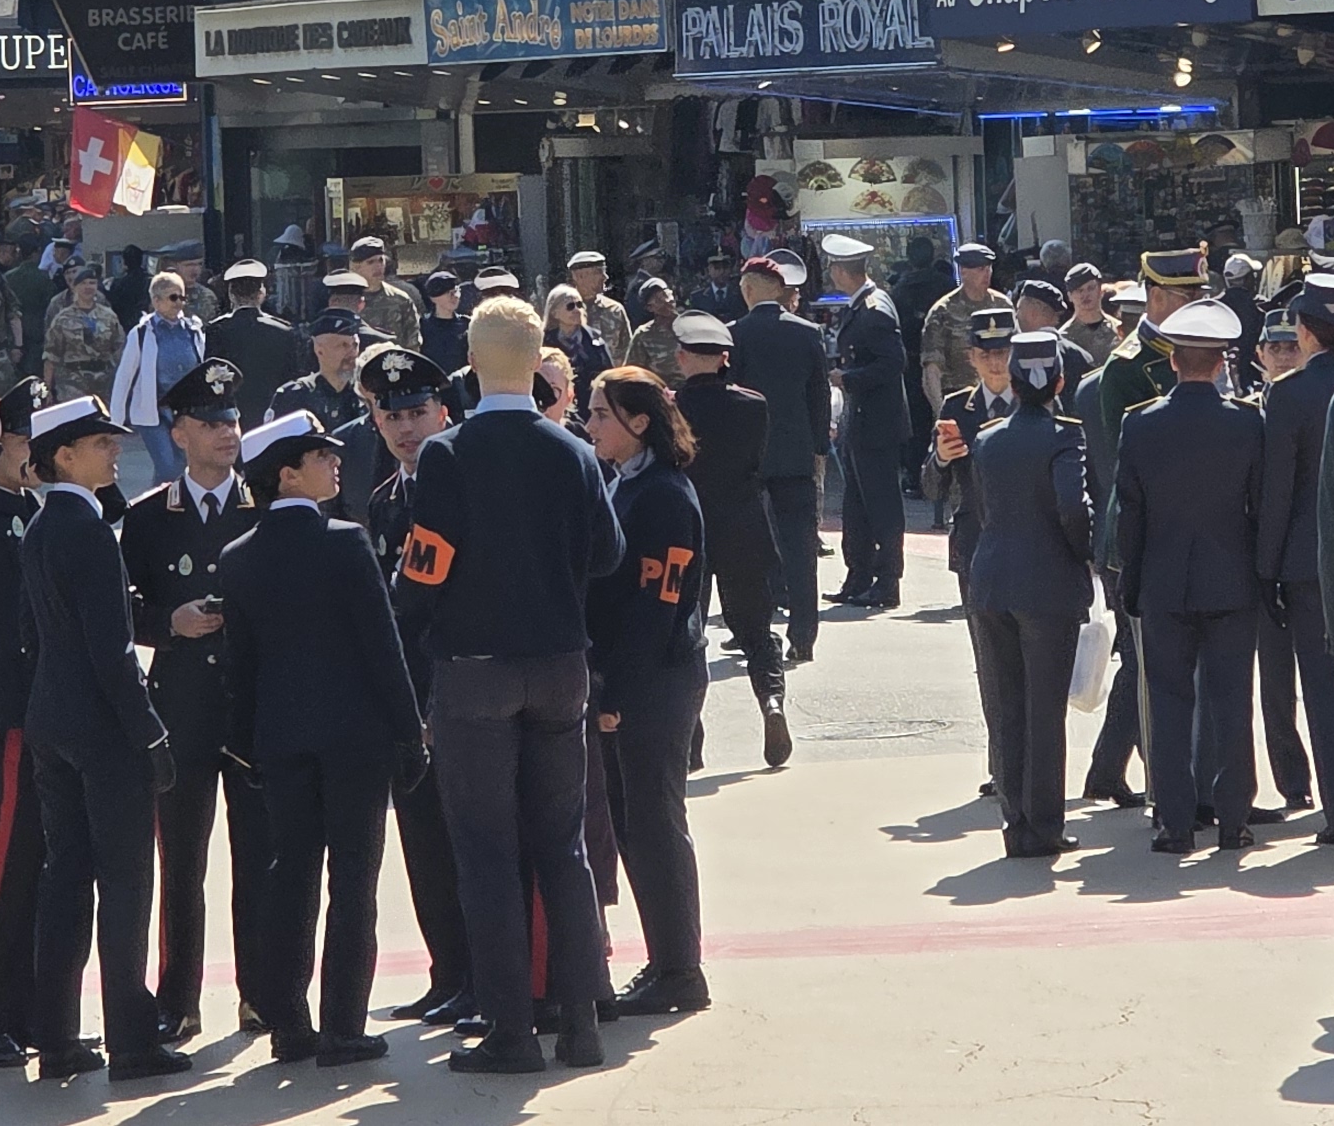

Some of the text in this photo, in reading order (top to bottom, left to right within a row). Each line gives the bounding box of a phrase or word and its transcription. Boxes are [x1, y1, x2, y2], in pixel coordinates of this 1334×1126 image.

[87, 5, 195, 28] BRASSERIE
[570, 1, 616, 23] NOTRE
[117, 26, 170, 51] CAFÉ
[430, 0, 490, 57] Saint
[574, 23, 660, 50] DE LOURDES
[681, 0, 807, 60] PALAIS
[204, 29, 225, 57] LA
